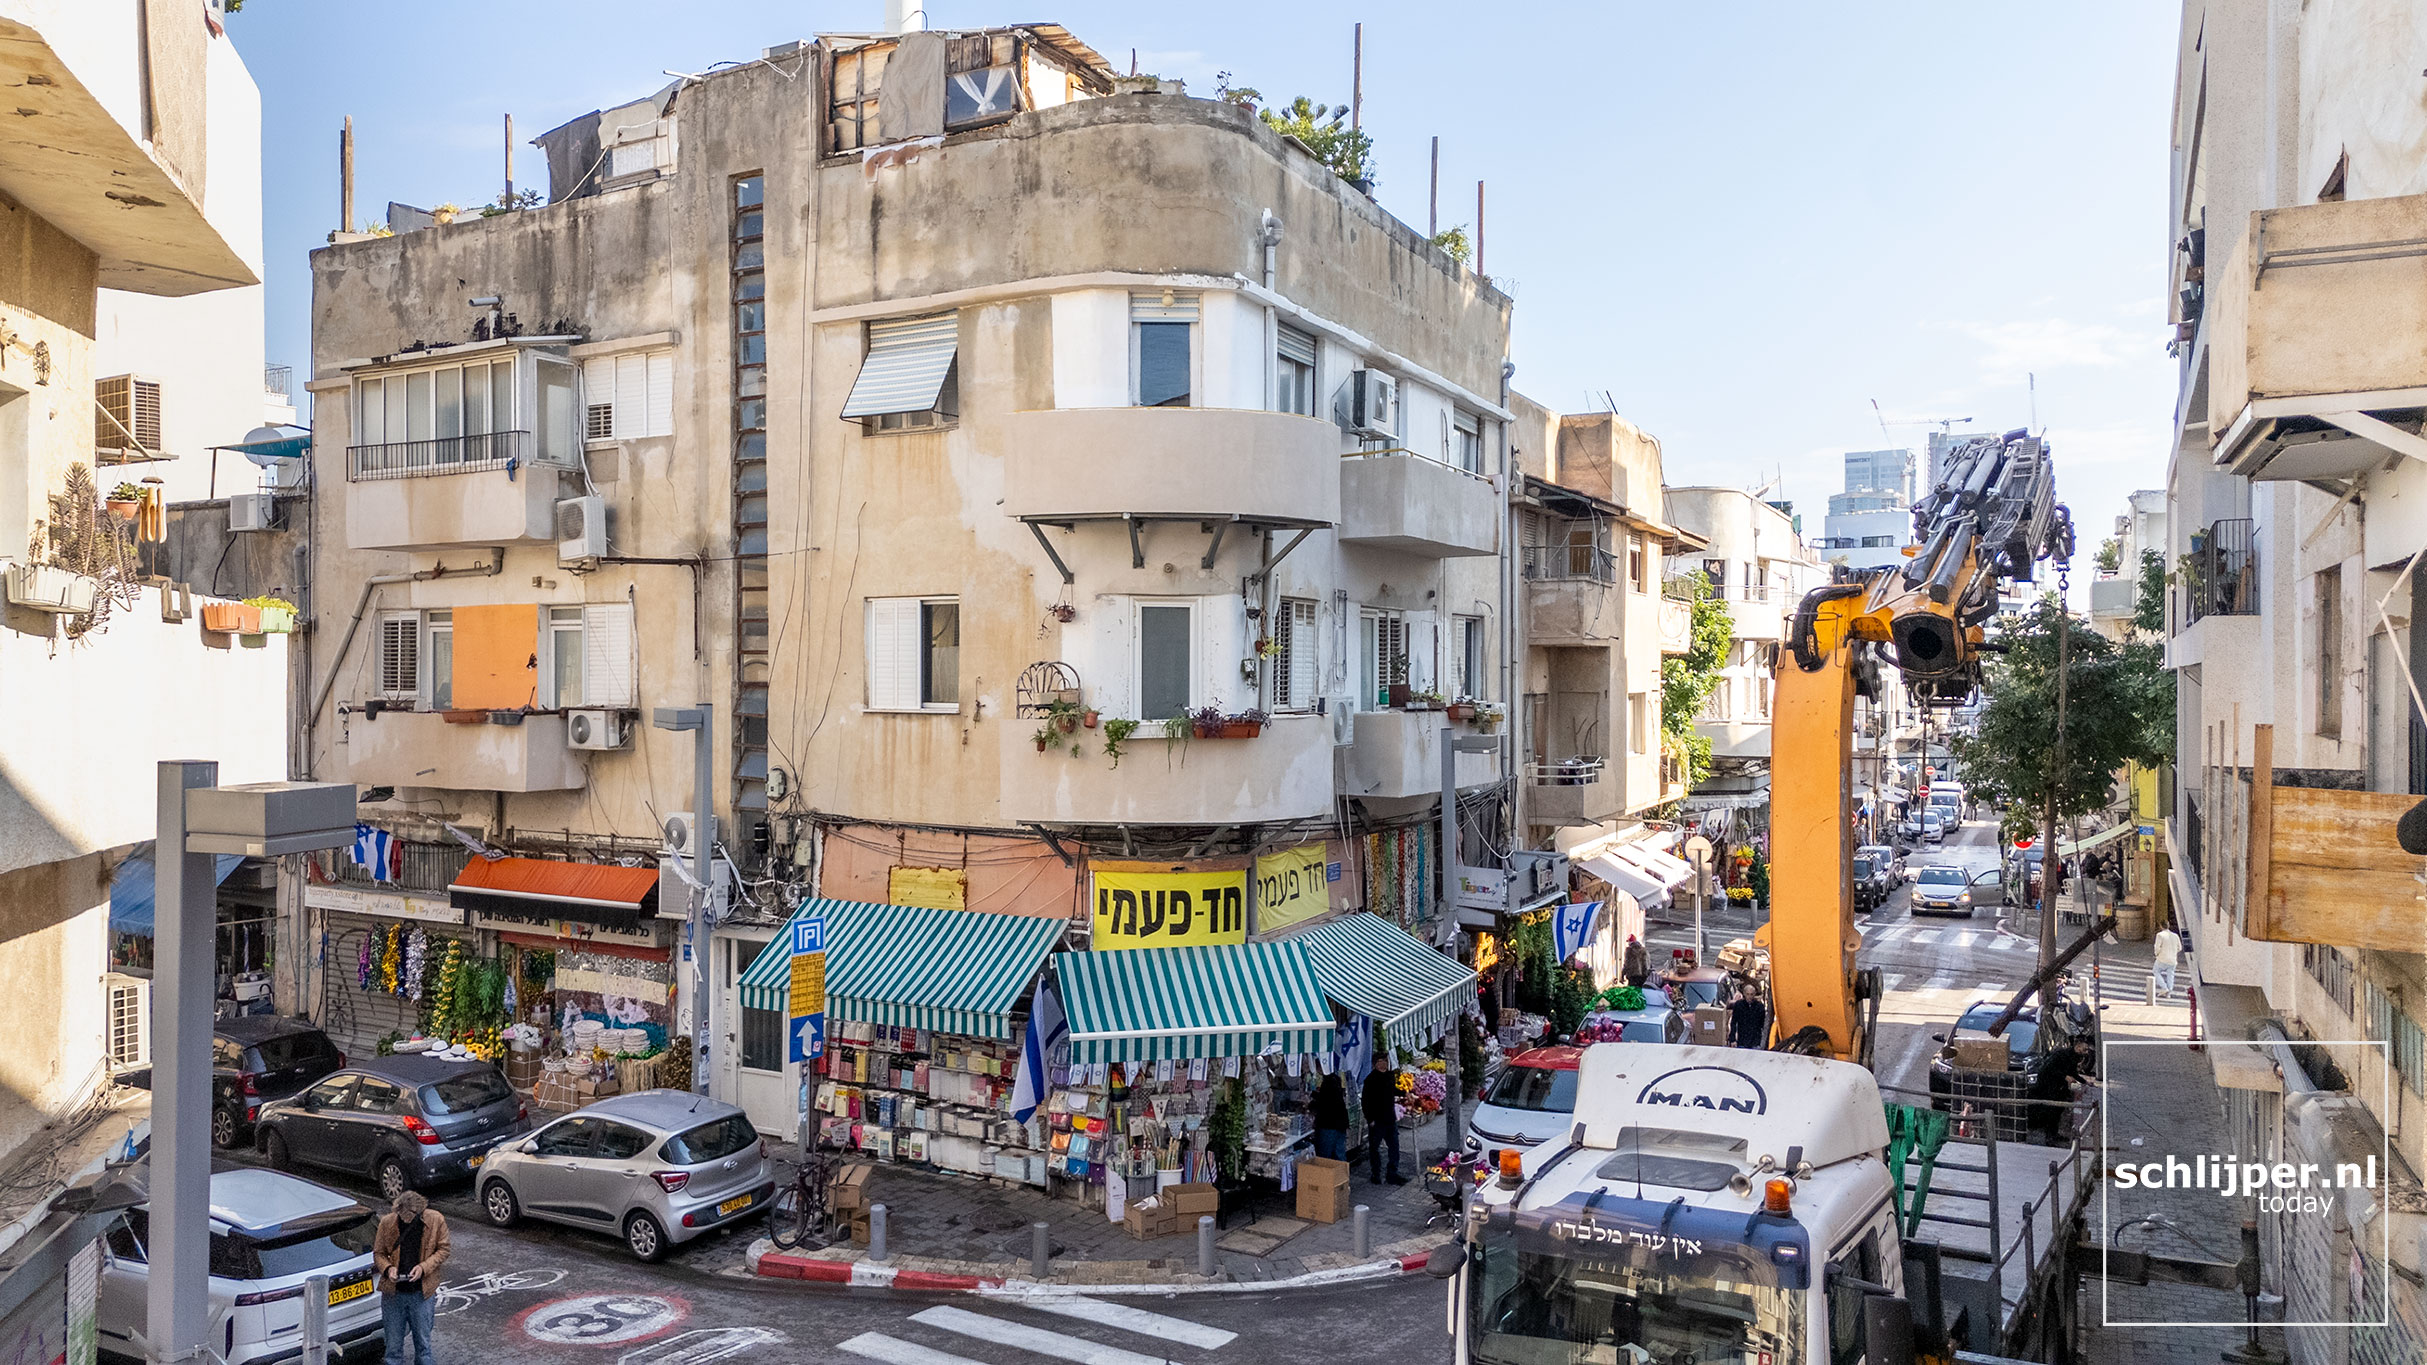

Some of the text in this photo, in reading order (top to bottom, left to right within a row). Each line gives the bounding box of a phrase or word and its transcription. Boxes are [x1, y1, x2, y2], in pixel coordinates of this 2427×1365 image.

[1257, 869, 1301, 908] פעמי
[1303, 861, 1325, 894] חד
[1099, 886, 1242, 939] חד-פעמי
[1647, 1091, 1756, 1114] MAN
[1555, 1217, 1703, 1260] אין עוד מלבדו
[544, 1296, 668, 1338] 30
